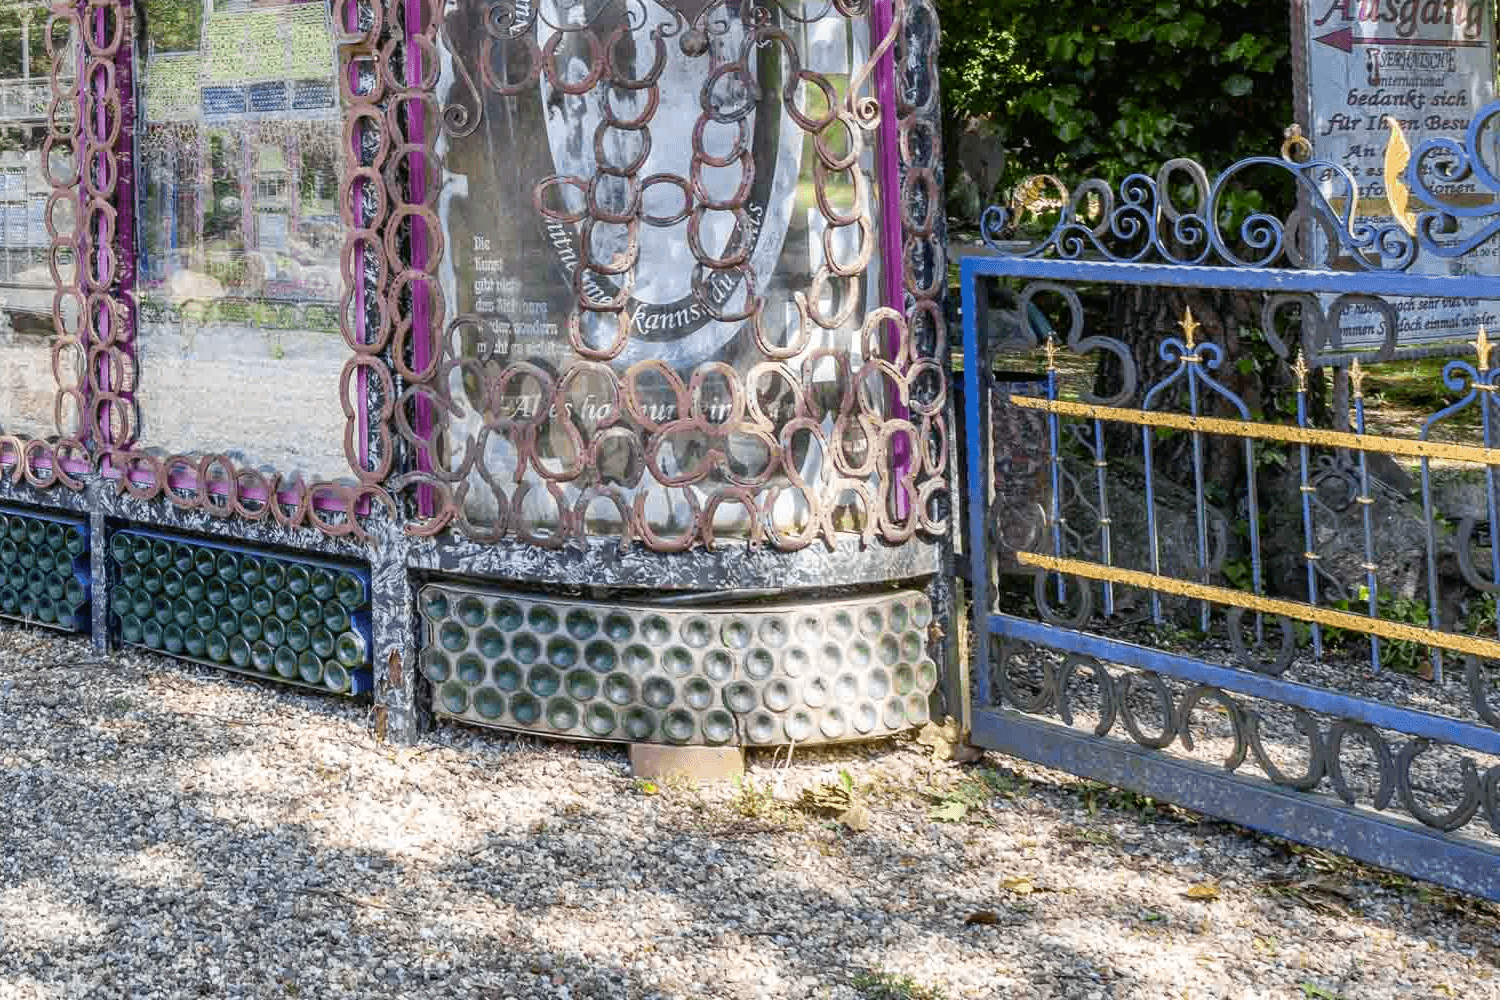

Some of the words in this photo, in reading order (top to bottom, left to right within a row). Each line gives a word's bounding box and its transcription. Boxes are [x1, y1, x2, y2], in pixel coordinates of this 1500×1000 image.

[1347, 88, 1426, 109] bedankt
[1430, 89, 1467, 106] sich
[1322, 113, 1361, 135] für
[1365, 114, 1420, 131] Ihen
[1425, 114, 1490, 131] Besu
[1343, 144, 1375, 159] An
[630, 302, 707, 336] kanns
[707, 272, 736, 304] du
